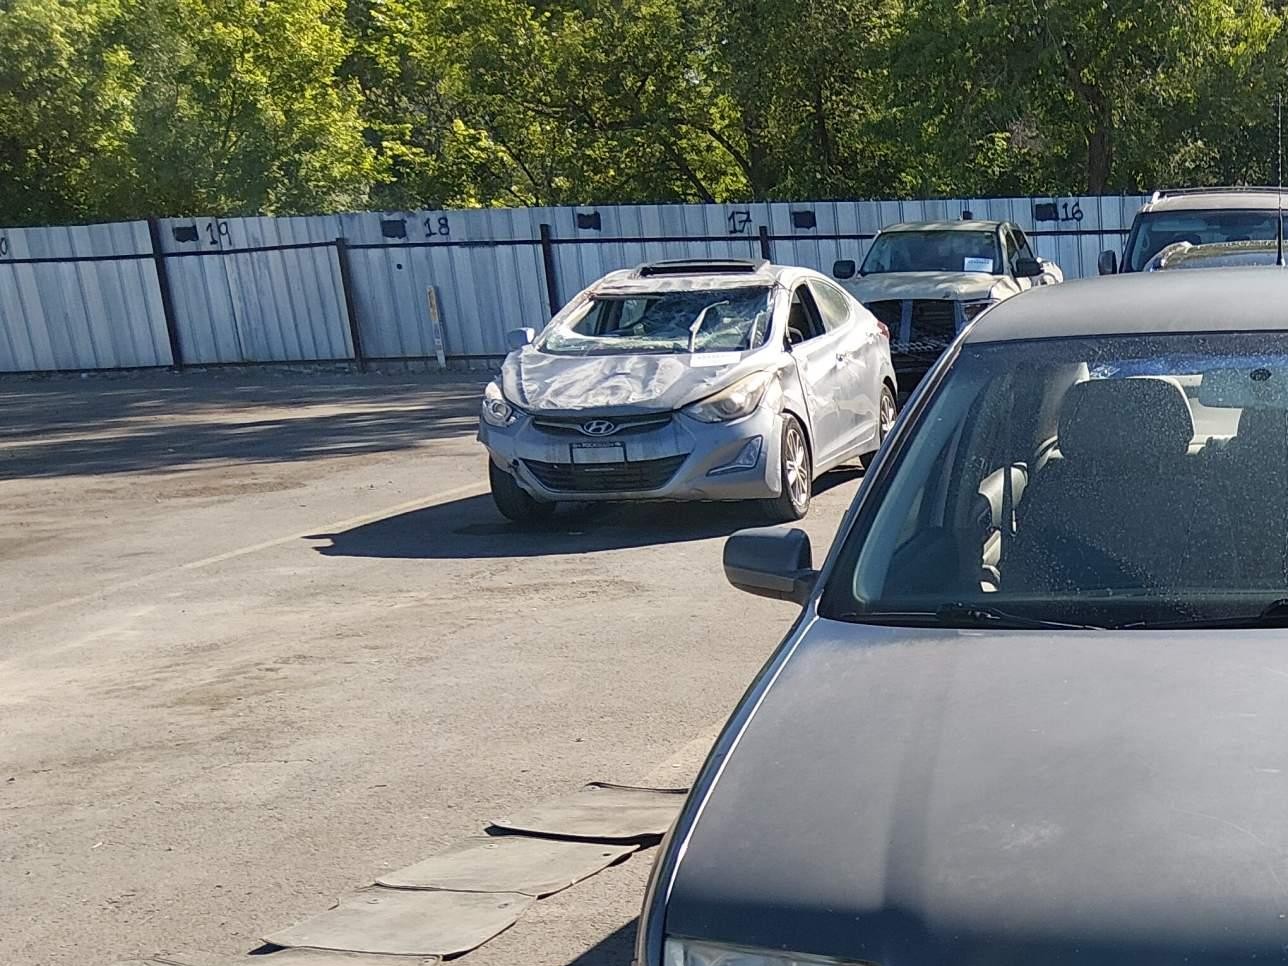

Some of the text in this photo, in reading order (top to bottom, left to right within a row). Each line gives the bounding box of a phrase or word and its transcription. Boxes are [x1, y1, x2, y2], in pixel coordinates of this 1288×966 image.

[728, 210, 752, 234] 17
[1060, 201, 1084, 222] 16
[206, 221, 232, 246] 19
[424, 216, 450, 237] 18
